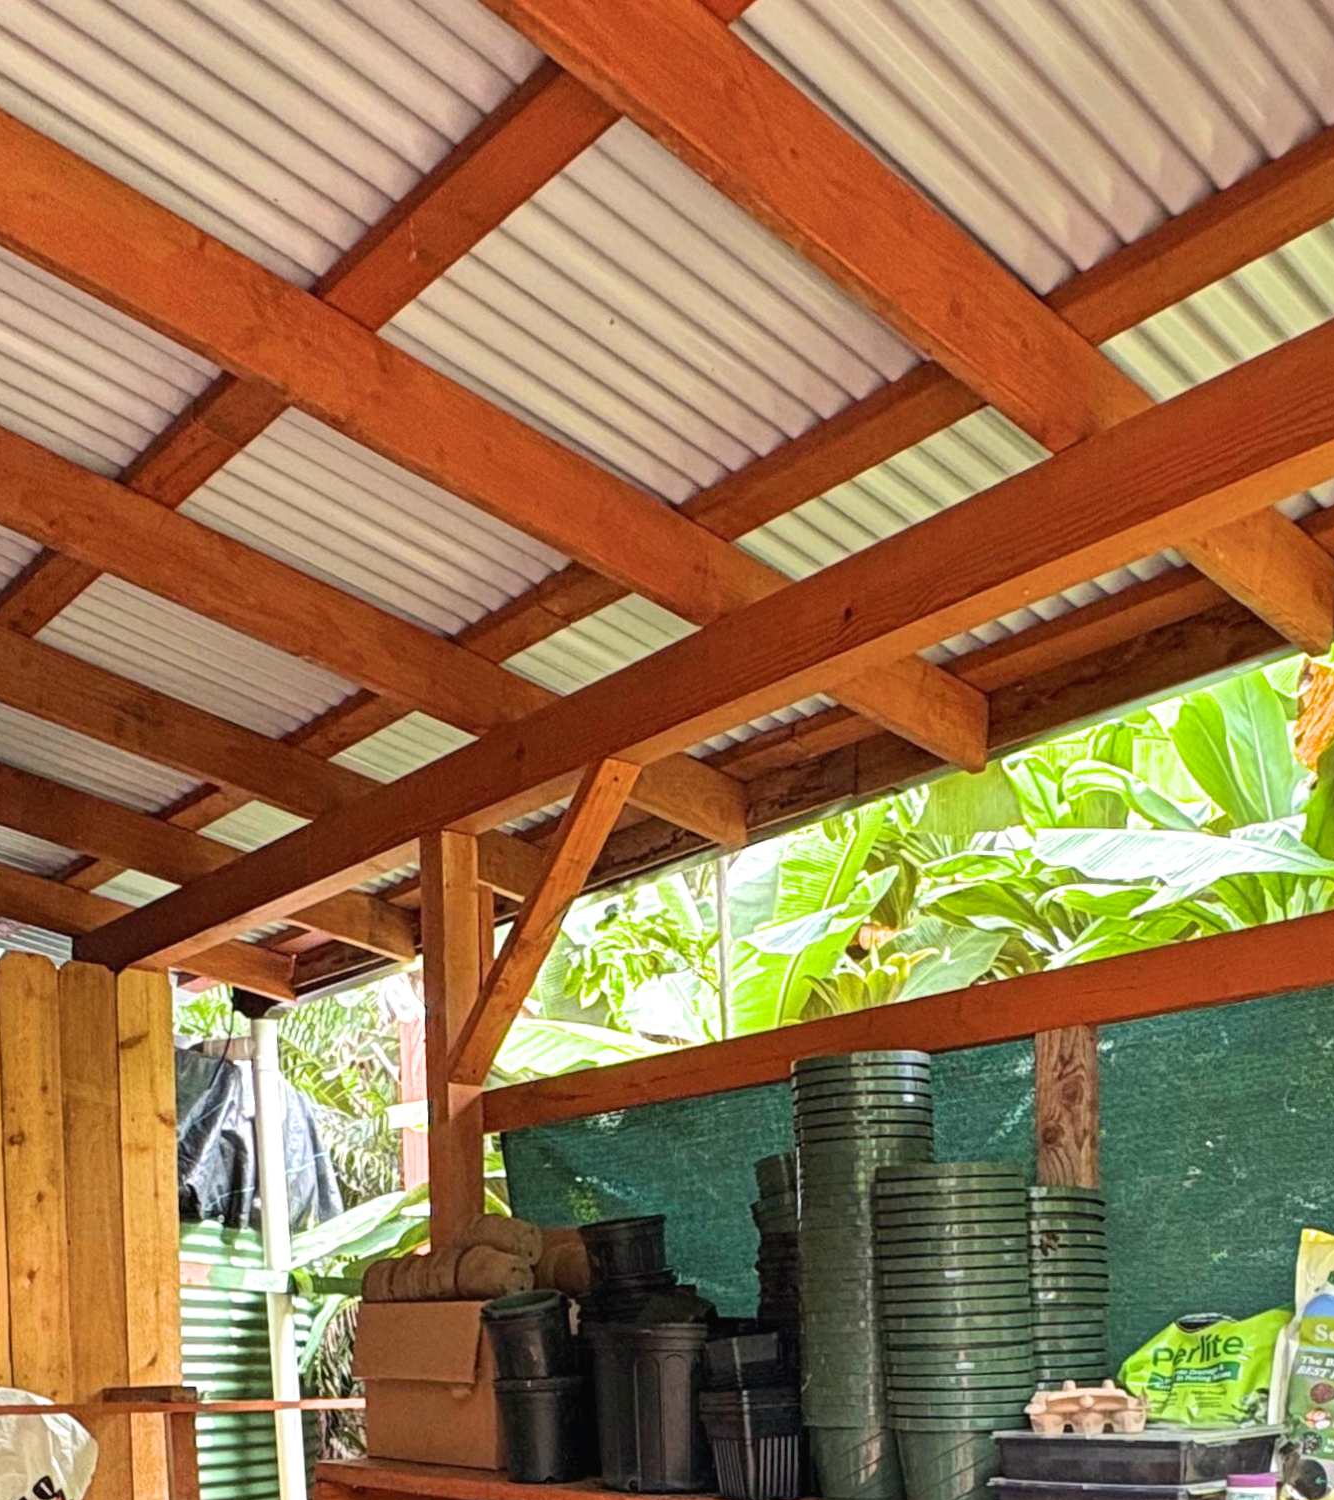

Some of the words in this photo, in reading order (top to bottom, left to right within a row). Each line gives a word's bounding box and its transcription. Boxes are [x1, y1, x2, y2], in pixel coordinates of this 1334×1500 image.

[1152, 1334, 1245, 1368] Perlite
[1300, 1356, 1323, 1365] The
[1296, 1366, 1327, 1378] BEST
